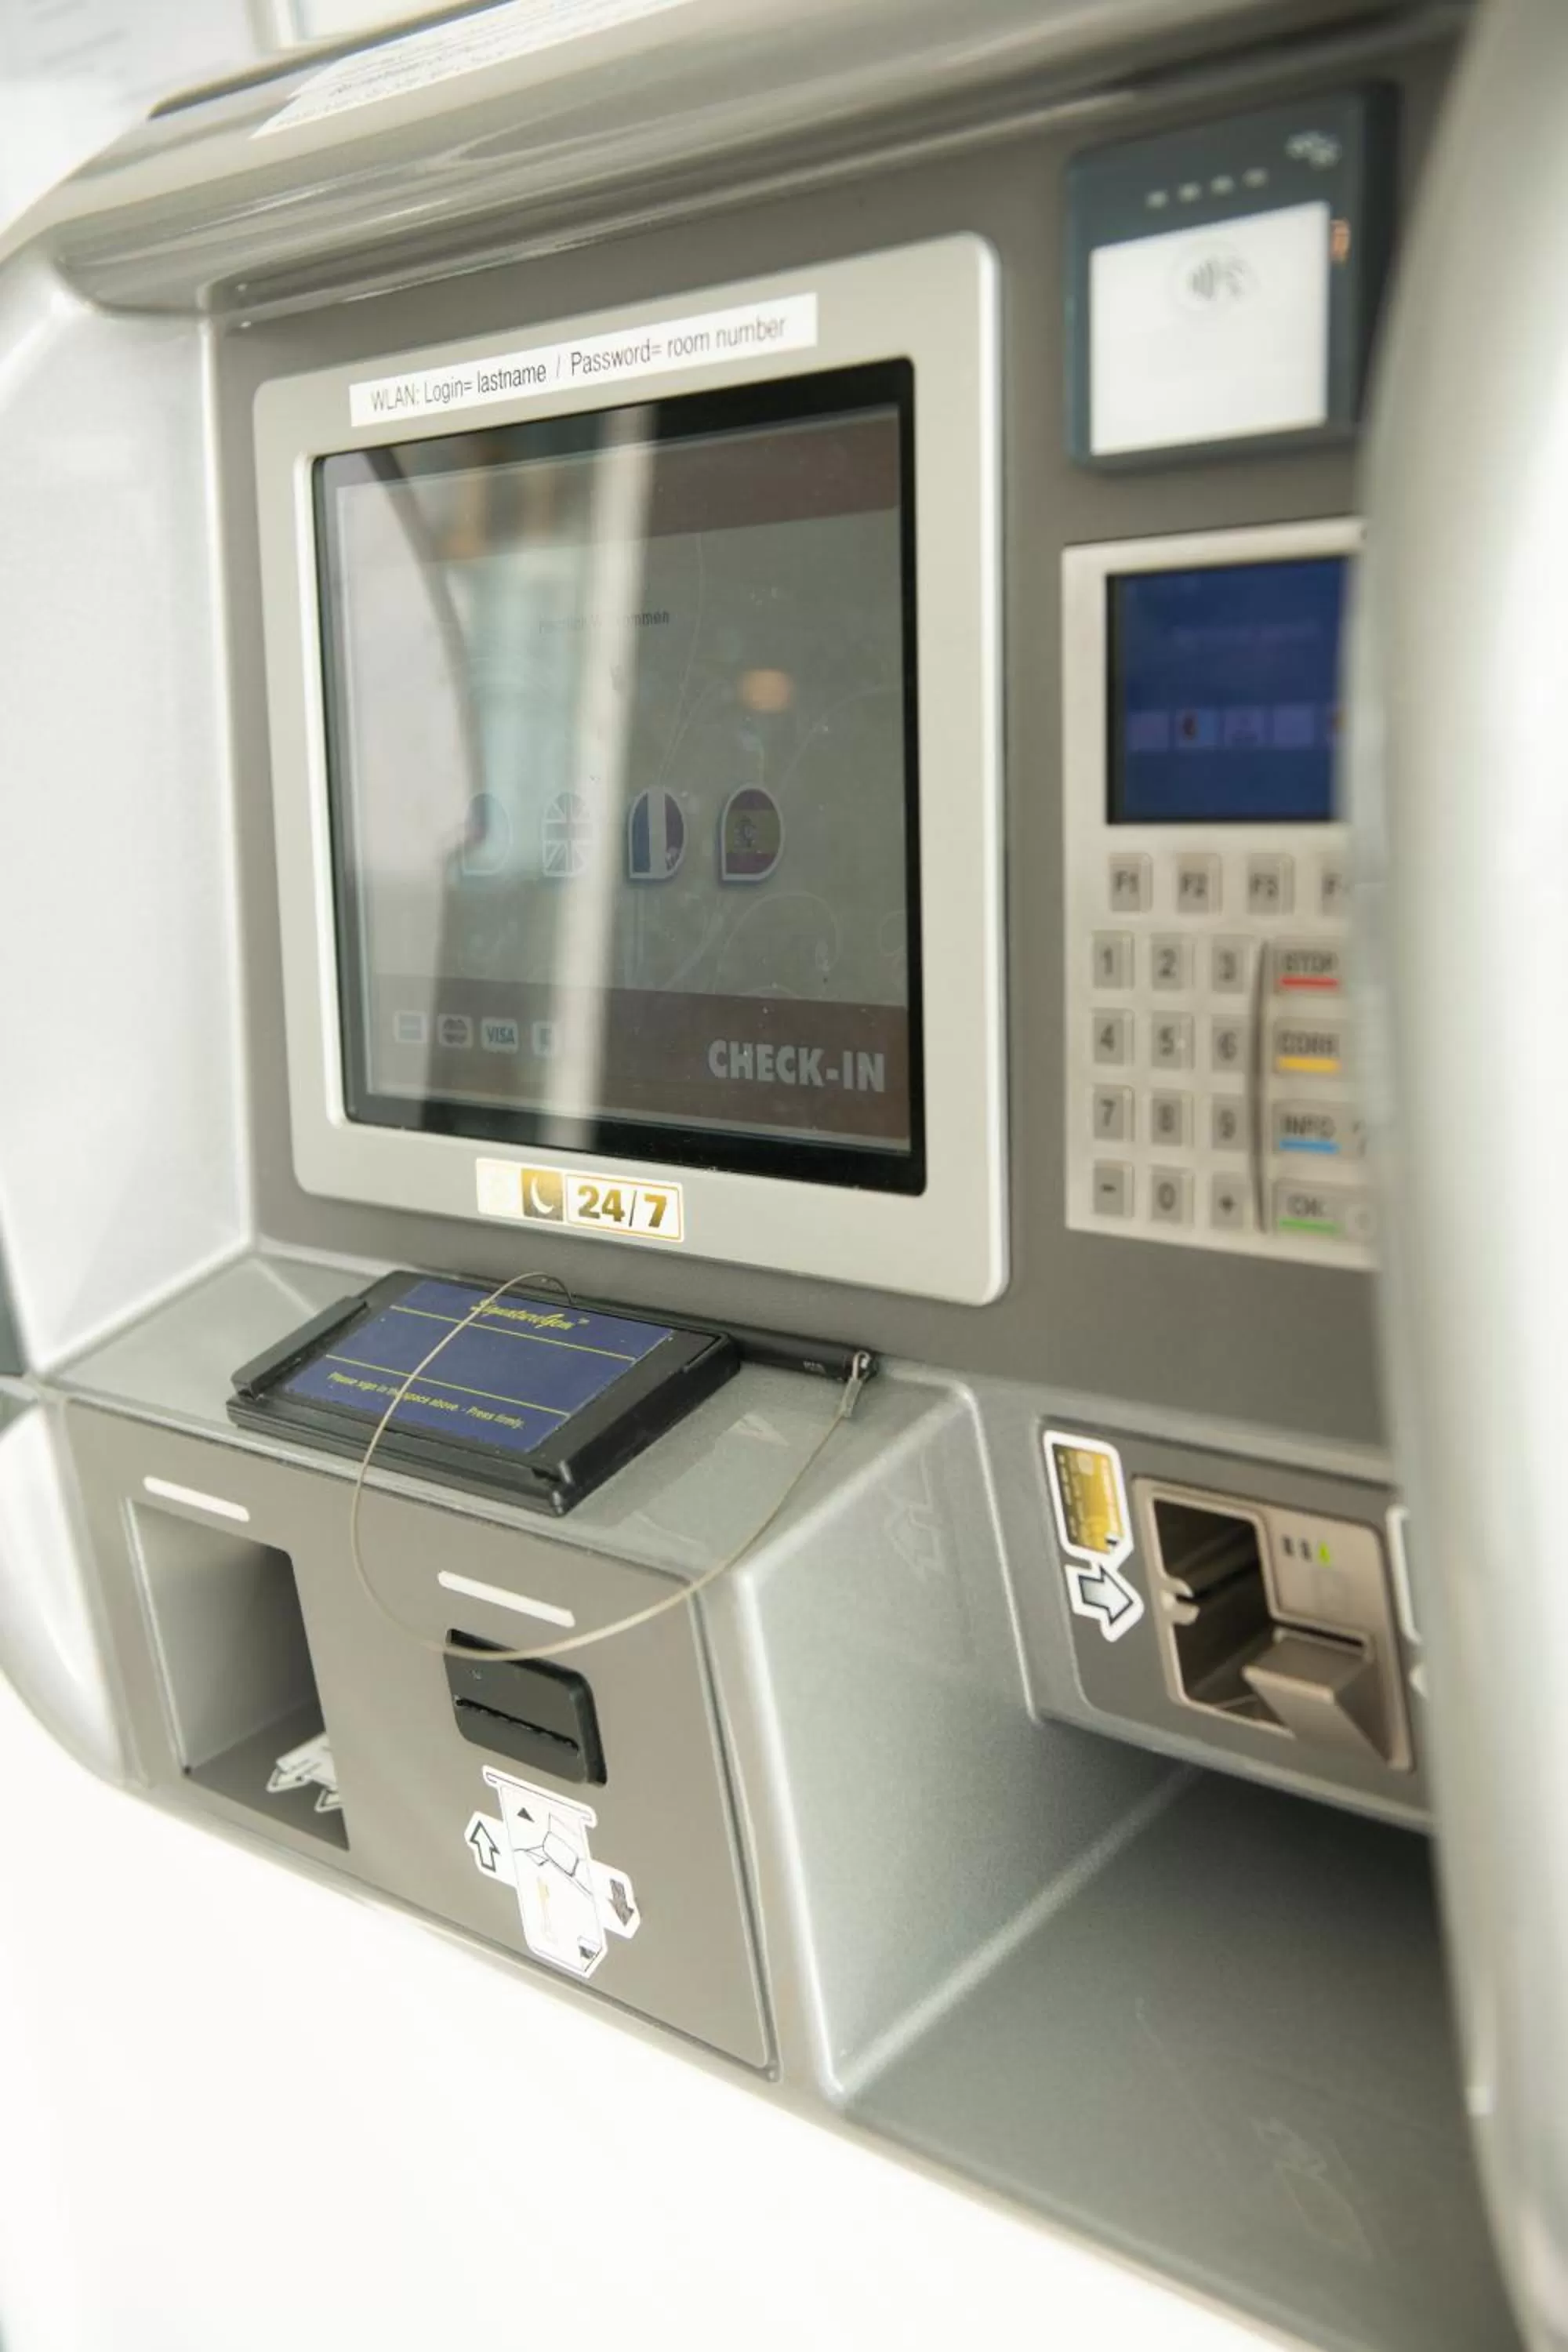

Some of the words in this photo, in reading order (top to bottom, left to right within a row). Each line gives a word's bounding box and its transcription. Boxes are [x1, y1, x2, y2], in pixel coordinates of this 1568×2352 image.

[372, 383, 421, 412] WLAN:
[424, 376, 473, 405] Login=
[477, 363, 546, 393] lastname
[571, 338, 662, 376] Password=
[667, 332, 710, 358] room
[716, 317, 786, 349] number
[1180, 872, 1208, 898] F2
[1102, 946, 1114, 976] 1
[1158, 948, 1177, 979] 2
[1218, 950, 1237, 982] 3
[488, 1026, 516, 1045] VISA
[1100, 1025, 1116, 1051] 4
[1158, 1025, 1176, 1057] 5
[1218, 1029, 1237, 1062] 6
[709, 1039, 886, 1092] CHECK-IN
[1101, 1099, 1116, 1127] 7
[1158, 1103, 1176, 1134] 8
[1218, 1109, 1237, 1141] 9
[577, 1185, 668, 1228] 24/7
[466, 1406, 494, 1421] Press
